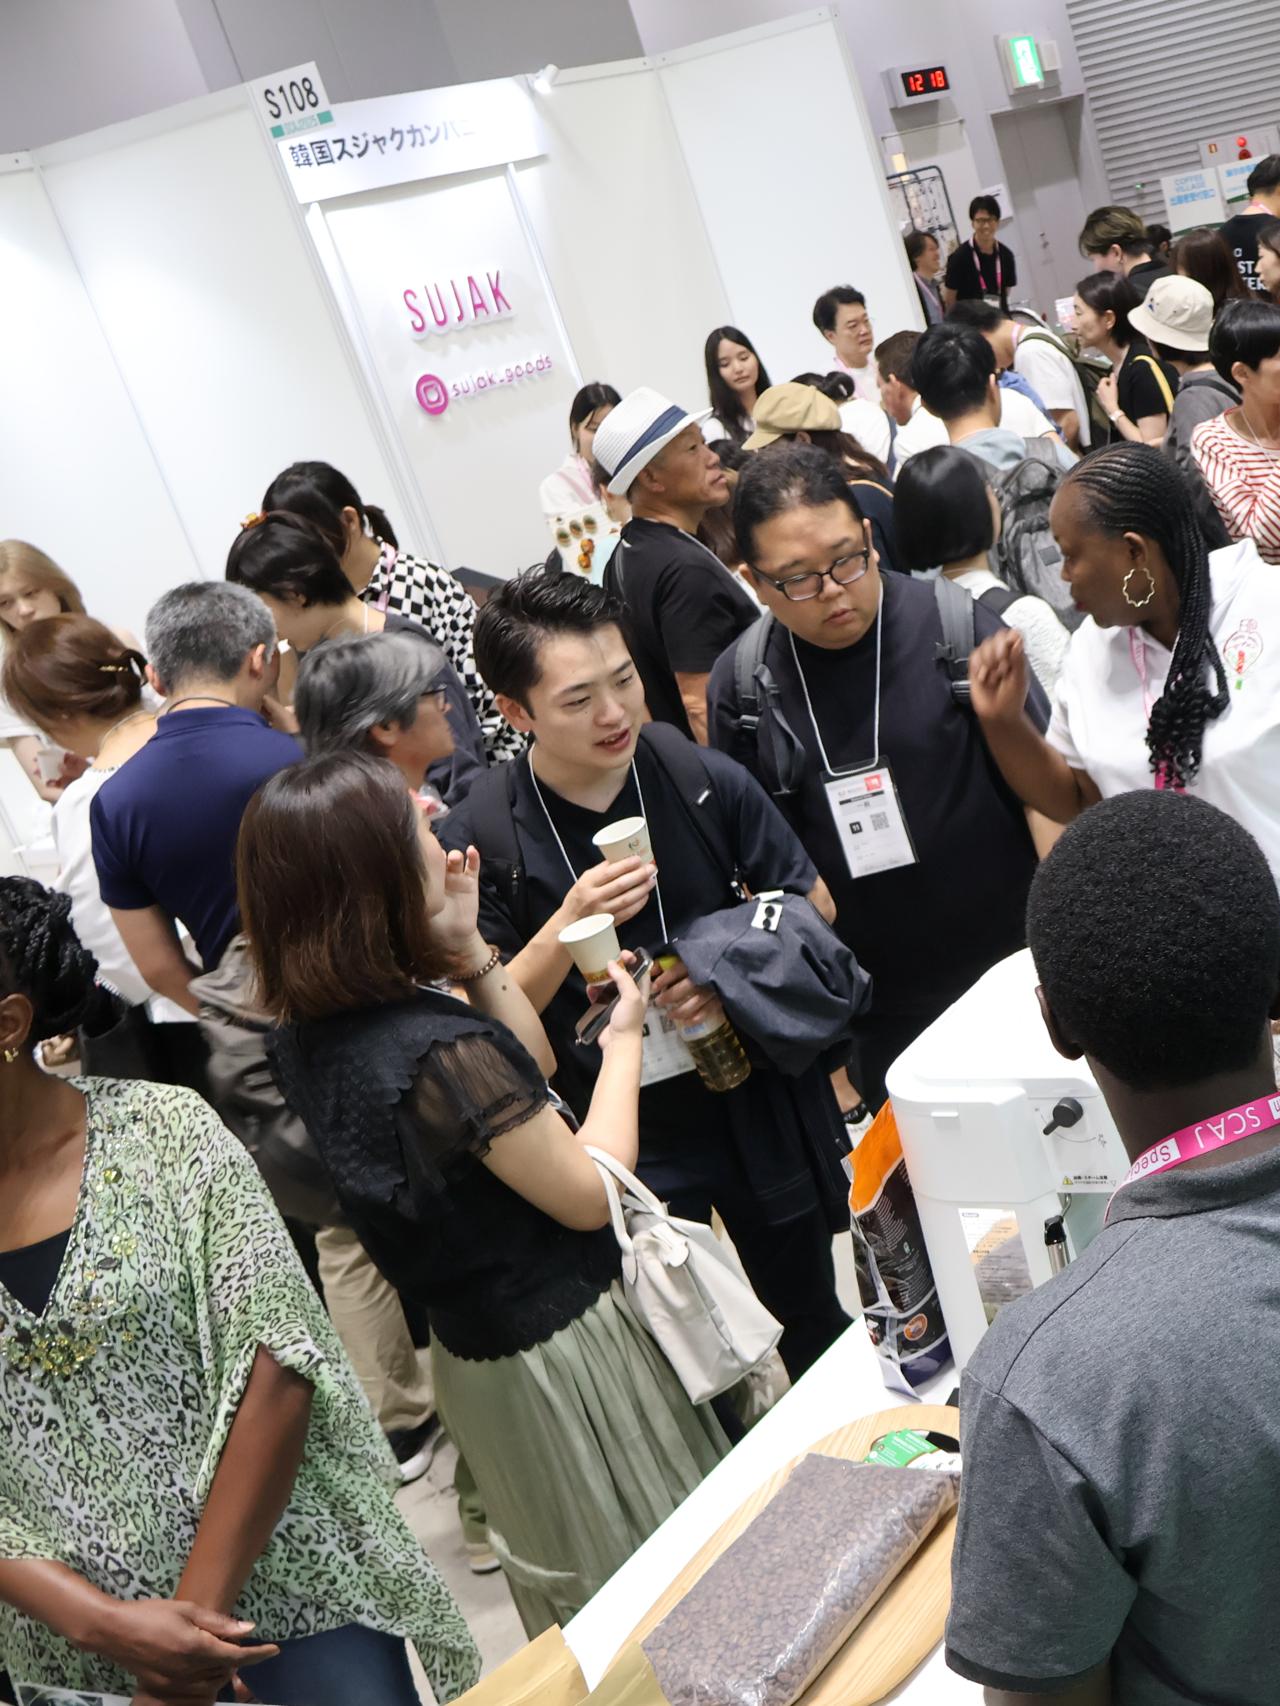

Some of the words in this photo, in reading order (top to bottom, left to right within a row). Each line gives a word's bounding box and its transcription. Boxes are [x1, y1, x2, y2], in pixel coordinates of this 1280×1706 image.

[264, 77, 319, 119] S108
[403, 270, 512, 332] SUJAK
[1194, 1106, 1261, 1149] SCAJ
[1128, 1145, 1171, 1178] Speci
